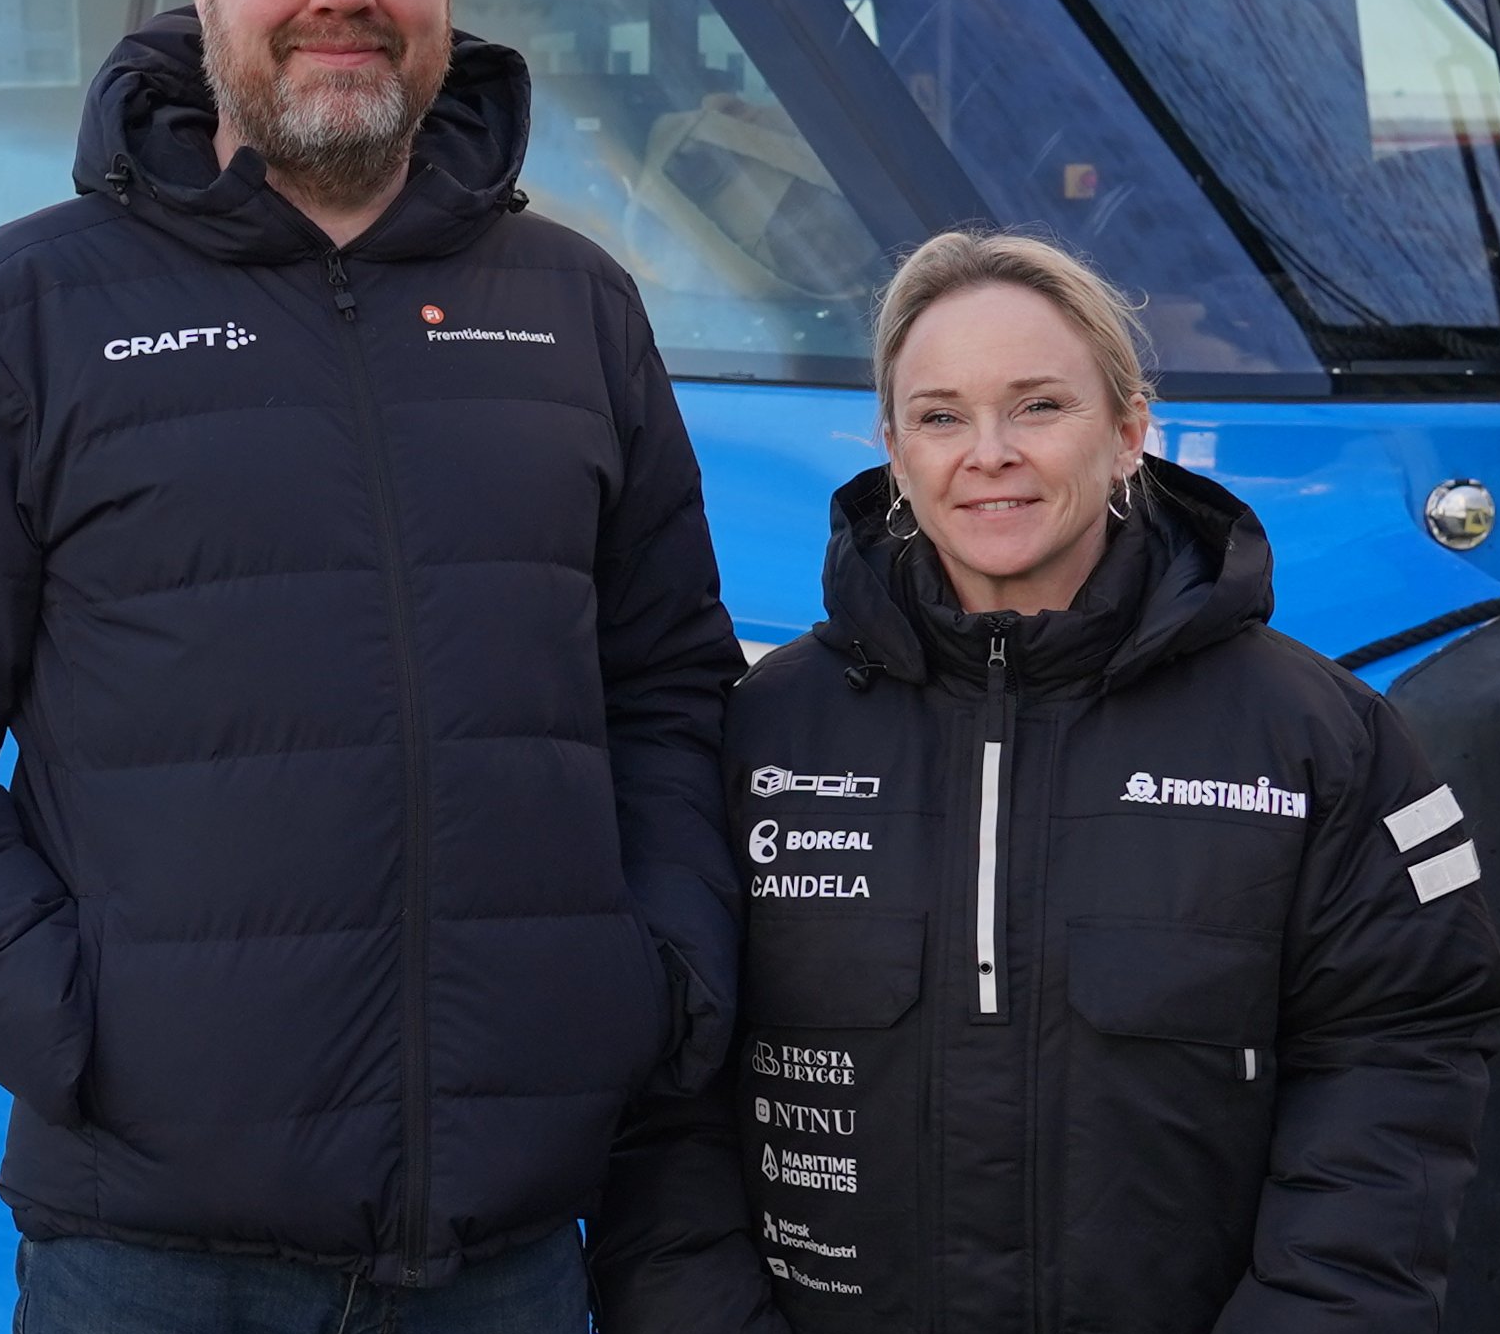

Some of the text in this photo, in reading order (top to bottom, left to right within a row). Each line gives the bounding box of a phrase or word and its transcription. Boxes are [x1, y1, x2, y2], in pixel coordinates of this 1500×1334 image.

[103, 326, 222, 361] CRAFT
[427, 328, 556, 344] Fremtidens Industri
[1161, 776, 1307, 819] FROSTABÅTEN
[786, 830, 873, 851] BOREAL
[751, 875, 870, 898] CANDELA
[781, 1045, 855, 1068] FROSTA
[782, 1062, 855, 1085] BRYGGE
[774, 1101, 856, 1135] NTNU
[781, 1149, 857, 1175] MARITIME
[781, 1168, 857, 1193] ROBOTICS
[779, 1218, 810, 1238] Norsk
[780, 1232, 857, 1258] Droneindustri
[830, 1280, 863, 1294] Havn
